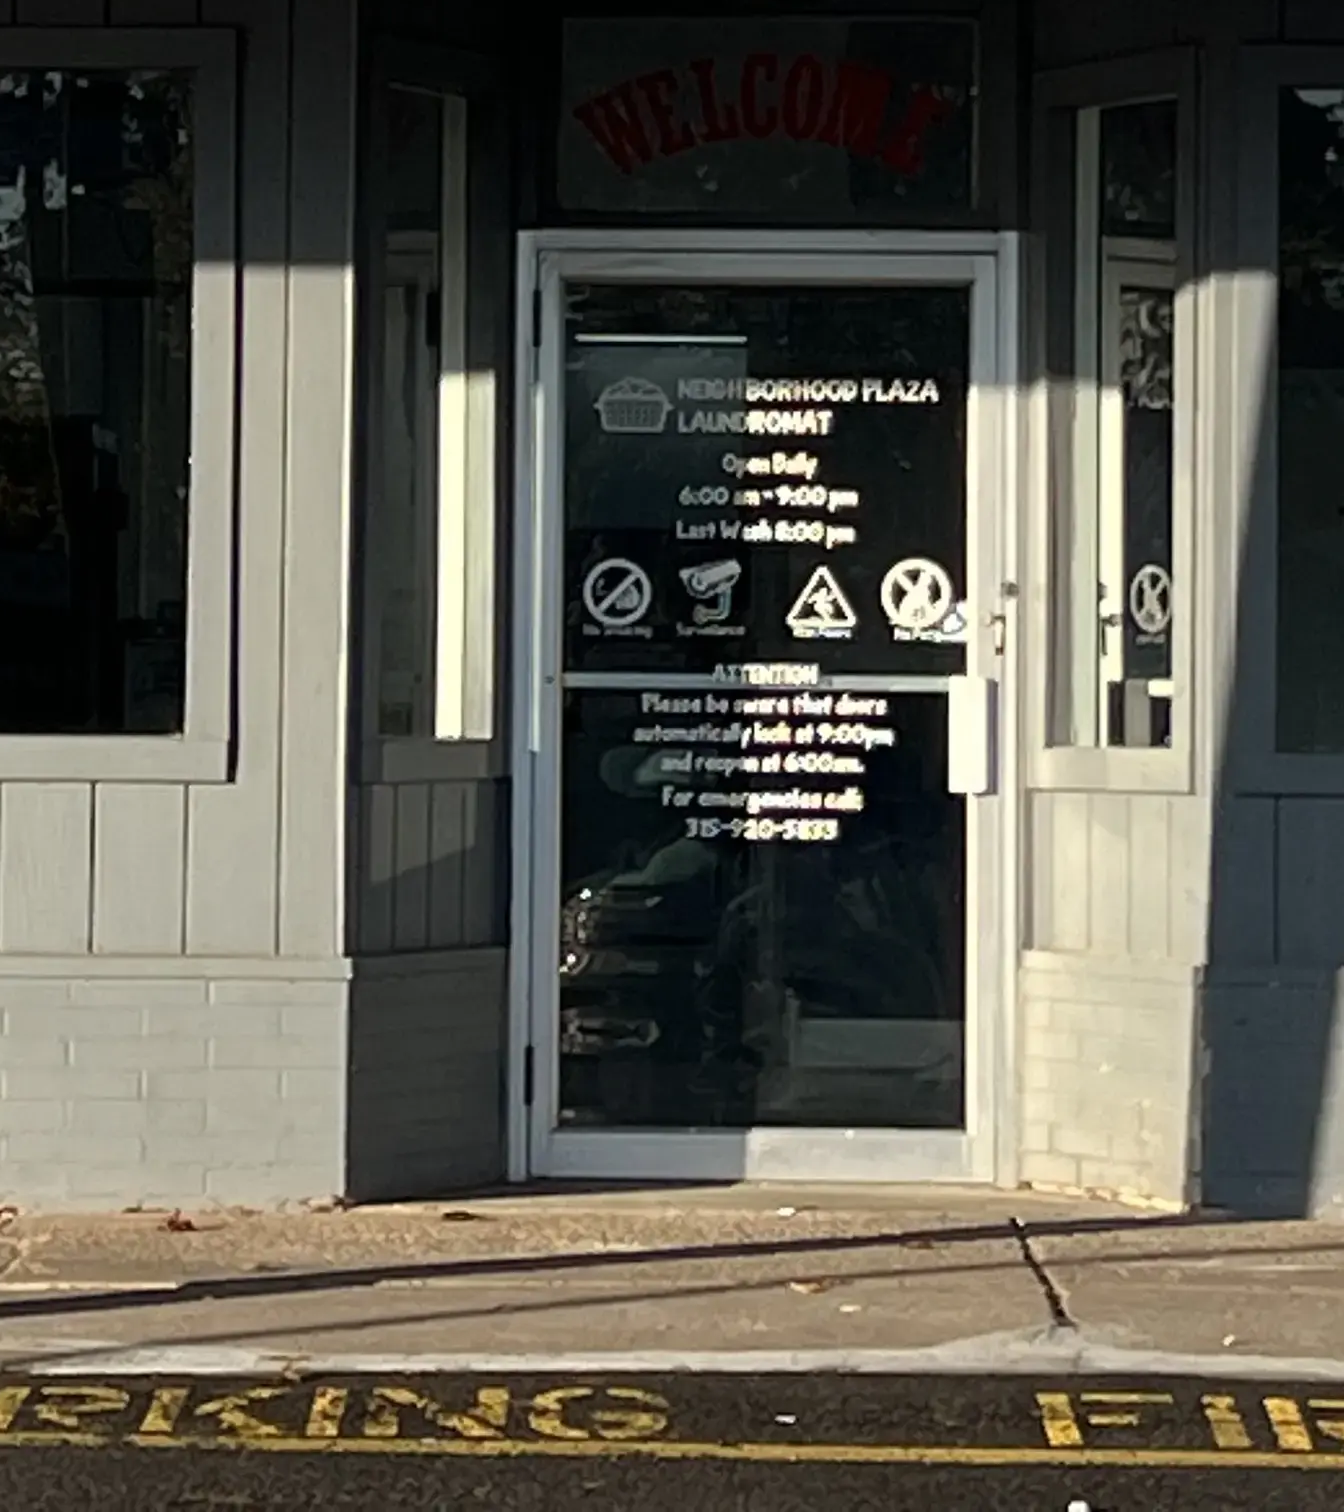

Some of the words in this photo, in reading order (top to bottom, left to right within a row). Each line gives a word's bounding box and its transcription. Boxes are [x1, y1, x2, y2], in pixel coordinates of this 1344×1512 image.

[862, 378, 940, 403] PLAZA
[677, 409, 834, 435] LAUNDROMAT
[722, 452, 770, 479] Open
[772, 451, 818, 479] Daily
[678, 486, 729, 506] 6:00
[775, 485, 826, 506] 9:00
[828, 490, 859, 513] pm
[676, 519, 716, 539] Last
[720, 518, 772, 542] Wash
[826, 525, 856, 549] pm
[712, 663, 819, 685] ATTENTION
[641, 692, 701, 714] Please
[706, 693, 729, 714] be
[733, 696, 789, 715] aware
[792, 691, 833, 716] that
[634, 723, 752, 748] automatically
[795, 723, 813, 745] at
[660, 751, 692, 772] and
[761, 751, 781, 773] at
[661, 785, 694, 807] For
[698, 788, 822, 814] emergencies
